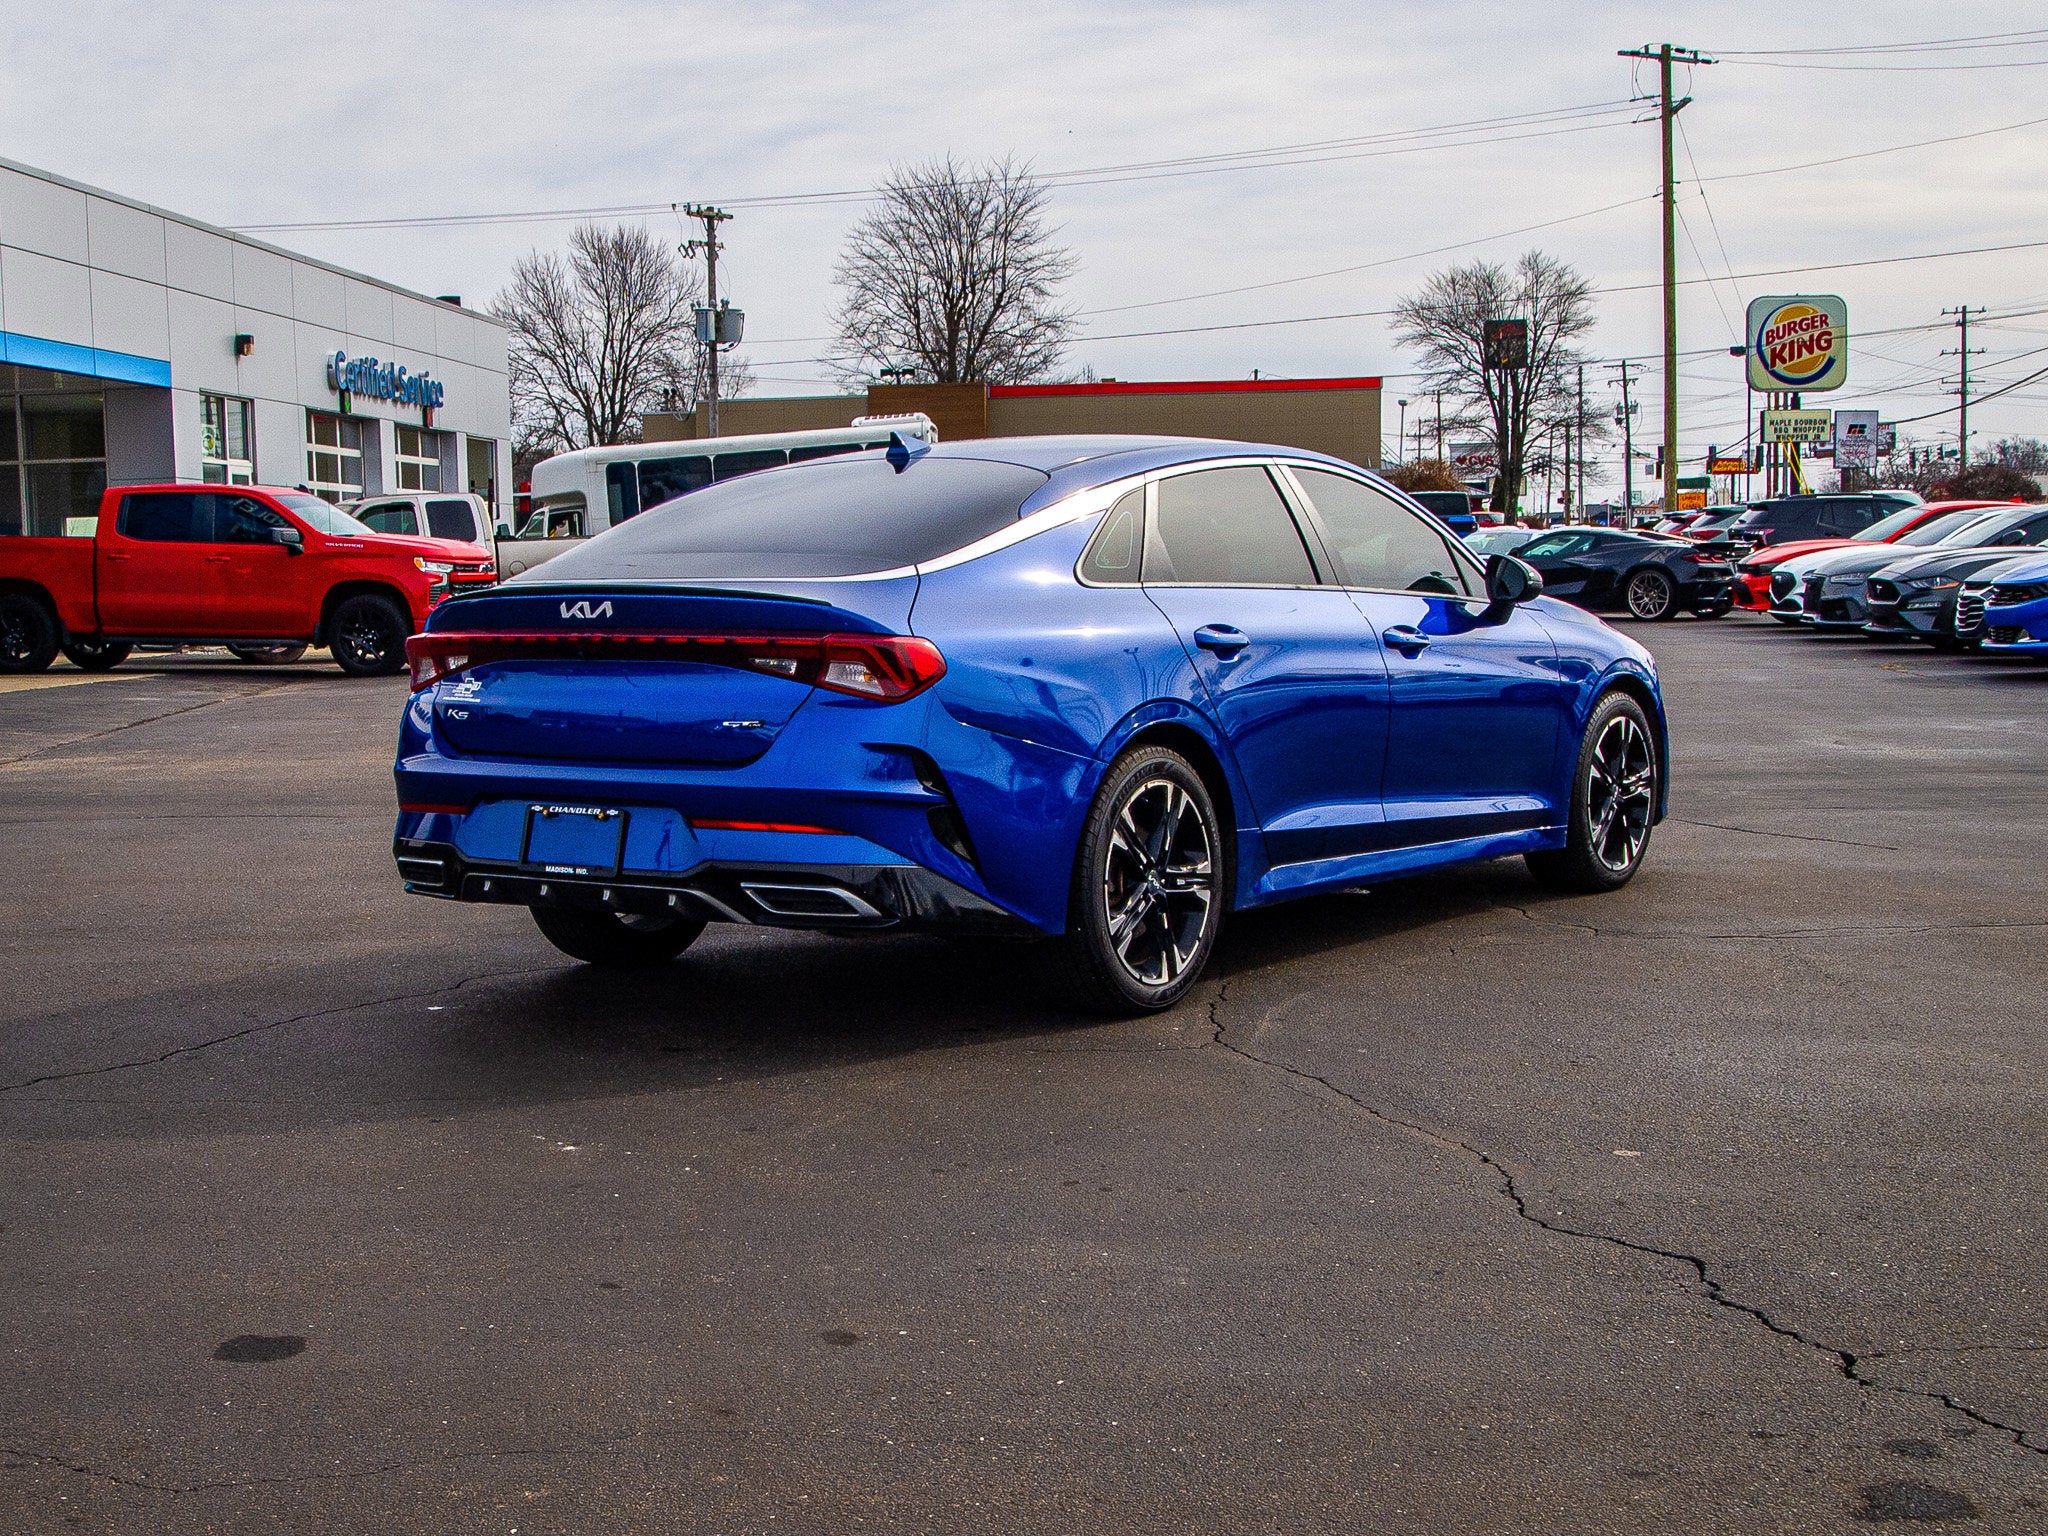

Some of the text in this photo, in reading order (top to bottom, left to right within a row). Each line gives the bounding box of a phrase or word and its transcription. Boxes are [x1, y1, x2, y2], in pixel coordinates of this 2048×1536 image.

[1765, 314, 1829, 346] BURGER
[1769, 331, 1832, 369] KING
[335, 350, 443, 408] Certified Service
[559, 601, 613, 619] KIA
[447, 708, 470, 720] K5
[549, 805, 601, 815] CHANDLER
